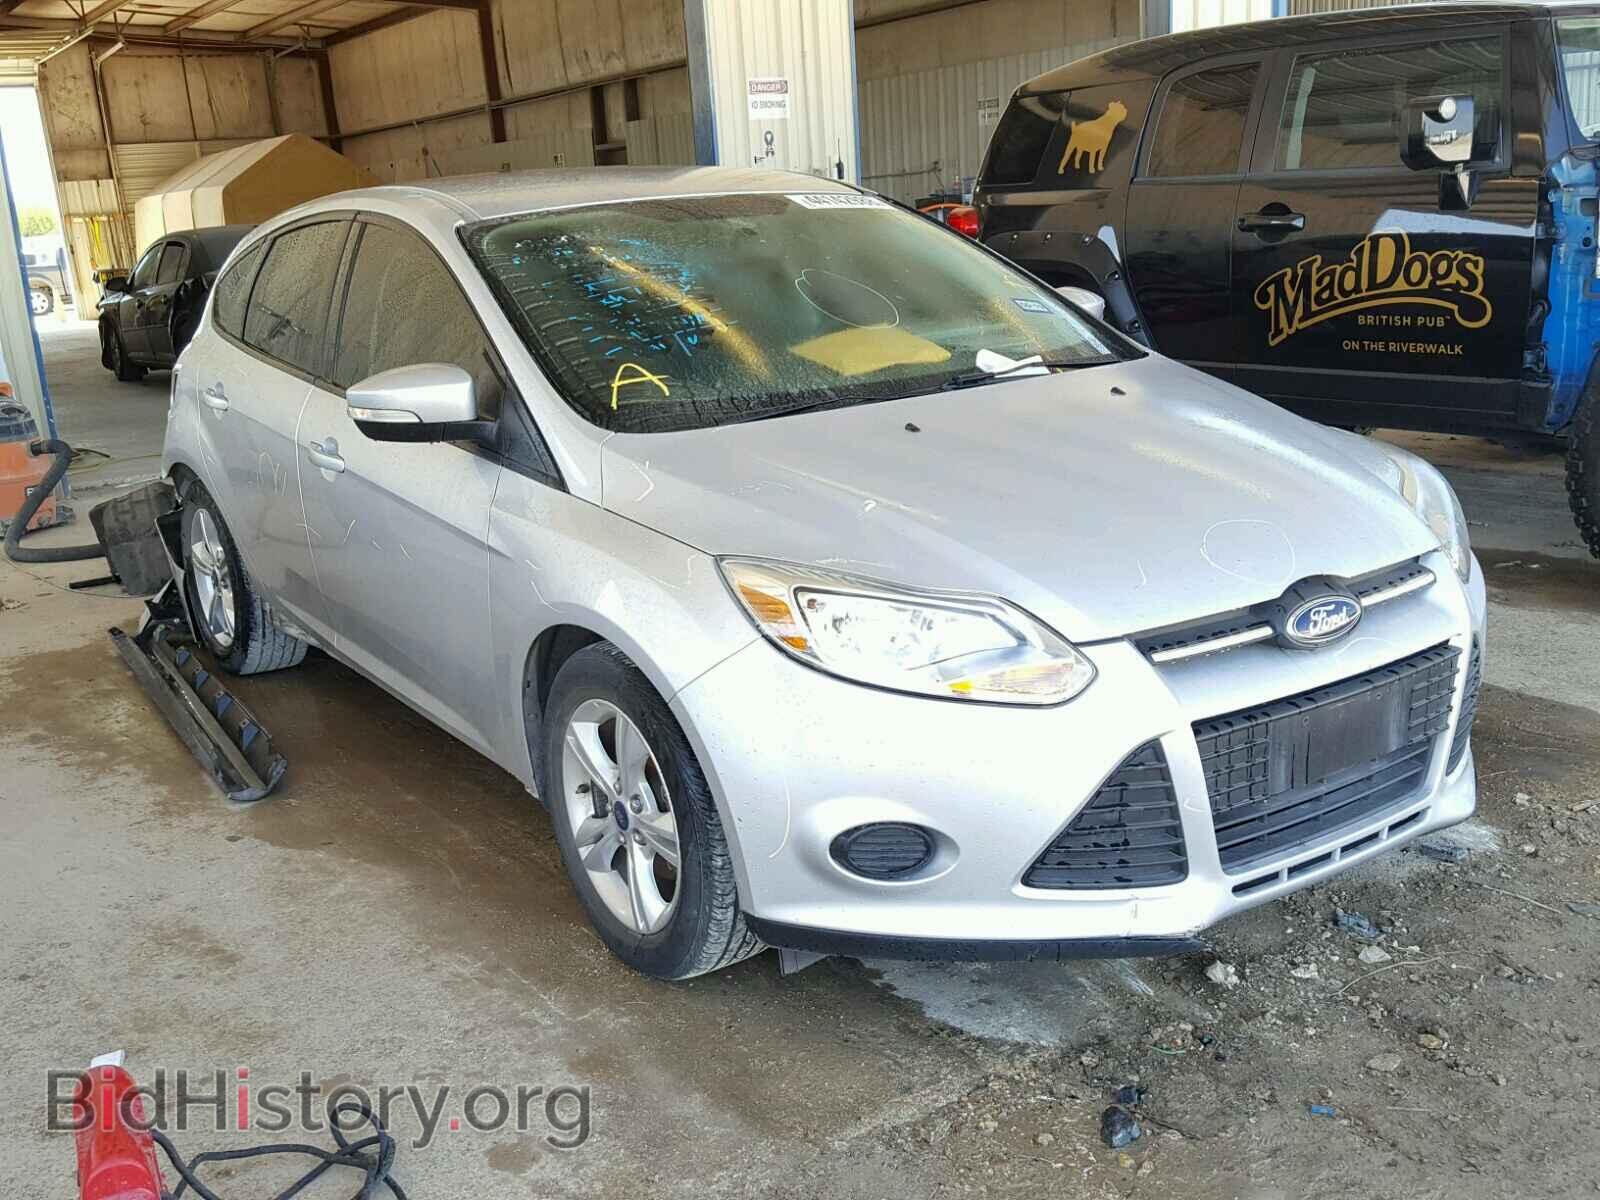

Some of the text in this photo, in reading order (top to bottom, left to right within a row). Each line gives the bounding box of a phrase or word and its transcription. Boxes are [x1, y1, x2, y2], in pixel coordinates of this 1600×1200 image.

[750, 83, 782, 92] DANGER
[1254, 229, 1487, 346] MadDogs
[1358, 315, 1411, 326] BRITISH
[1342, 340, 1463, 355] ON THE RIVERWALK
[1308, 604, 1349, 636] Ford
